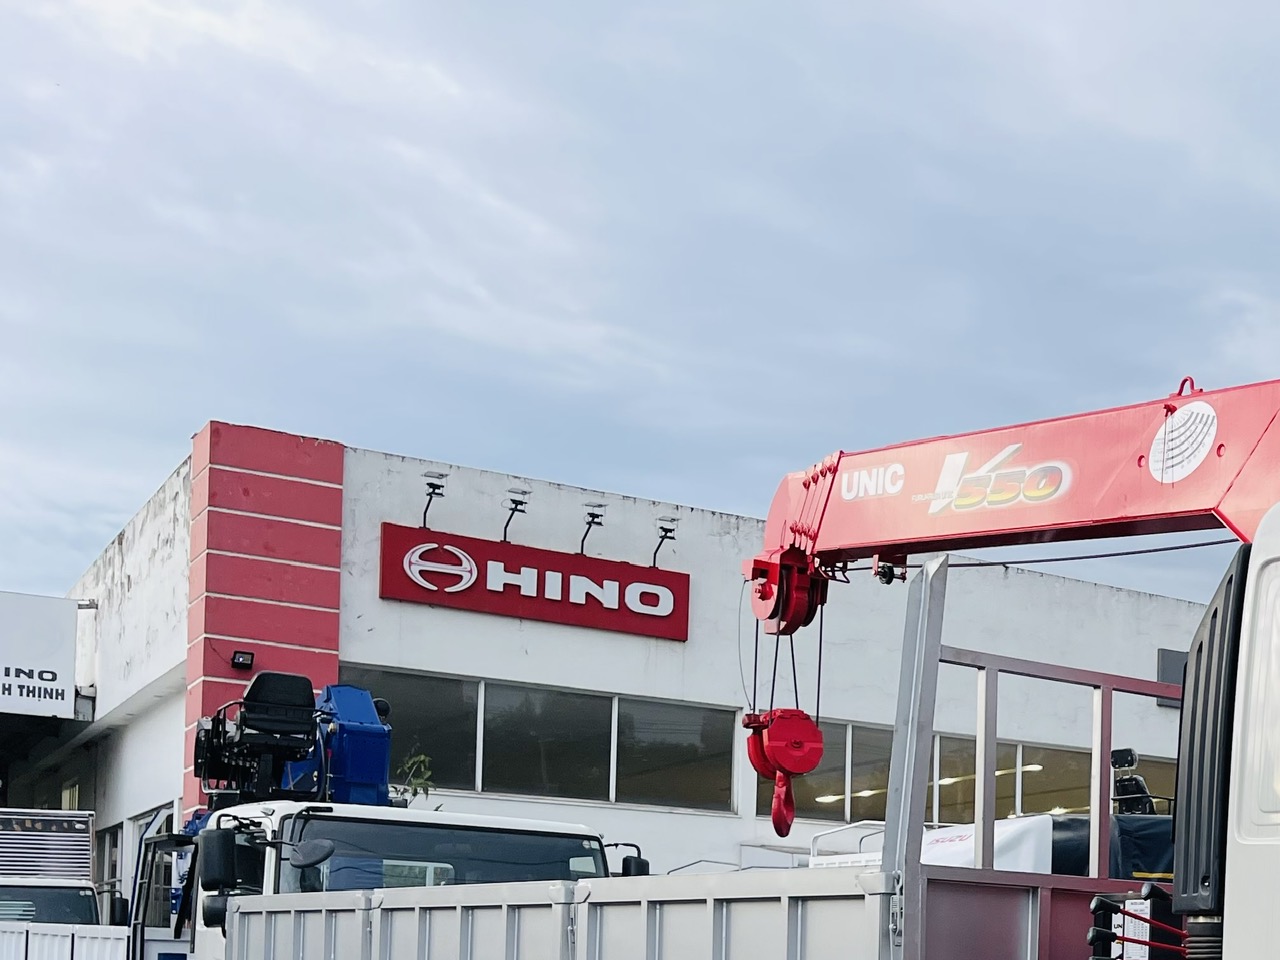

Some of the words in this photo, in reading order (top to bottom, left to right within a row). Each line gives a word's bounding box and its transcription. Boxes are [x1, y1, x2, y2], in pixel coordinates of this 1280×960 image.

[841, 463, 905, 500] UNIC
[486, 560, 675, 617] HINO
[17, 684, 65, 702] THỊNH
